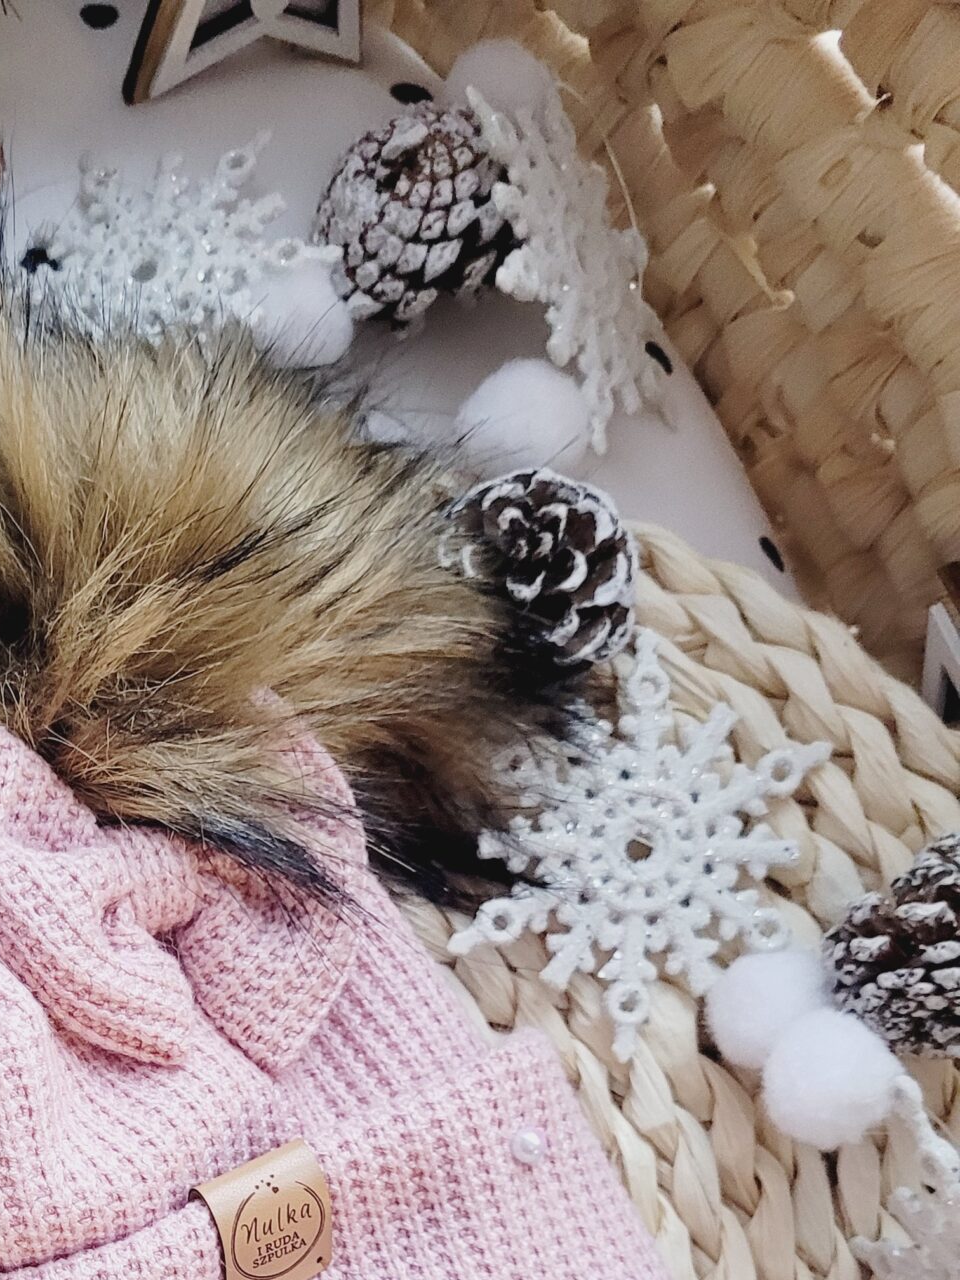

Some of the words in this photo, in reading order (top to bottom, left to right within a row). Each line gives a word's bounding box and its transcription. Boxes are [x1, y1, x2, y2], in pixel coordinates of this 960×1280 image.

[241, 1203, 313, 1245] Nulka
[252, 1238, 307, 1269] SZPULKA
[257, 1246, 262, 1257] I
[265, 1231, 300, 1253] RUDA
